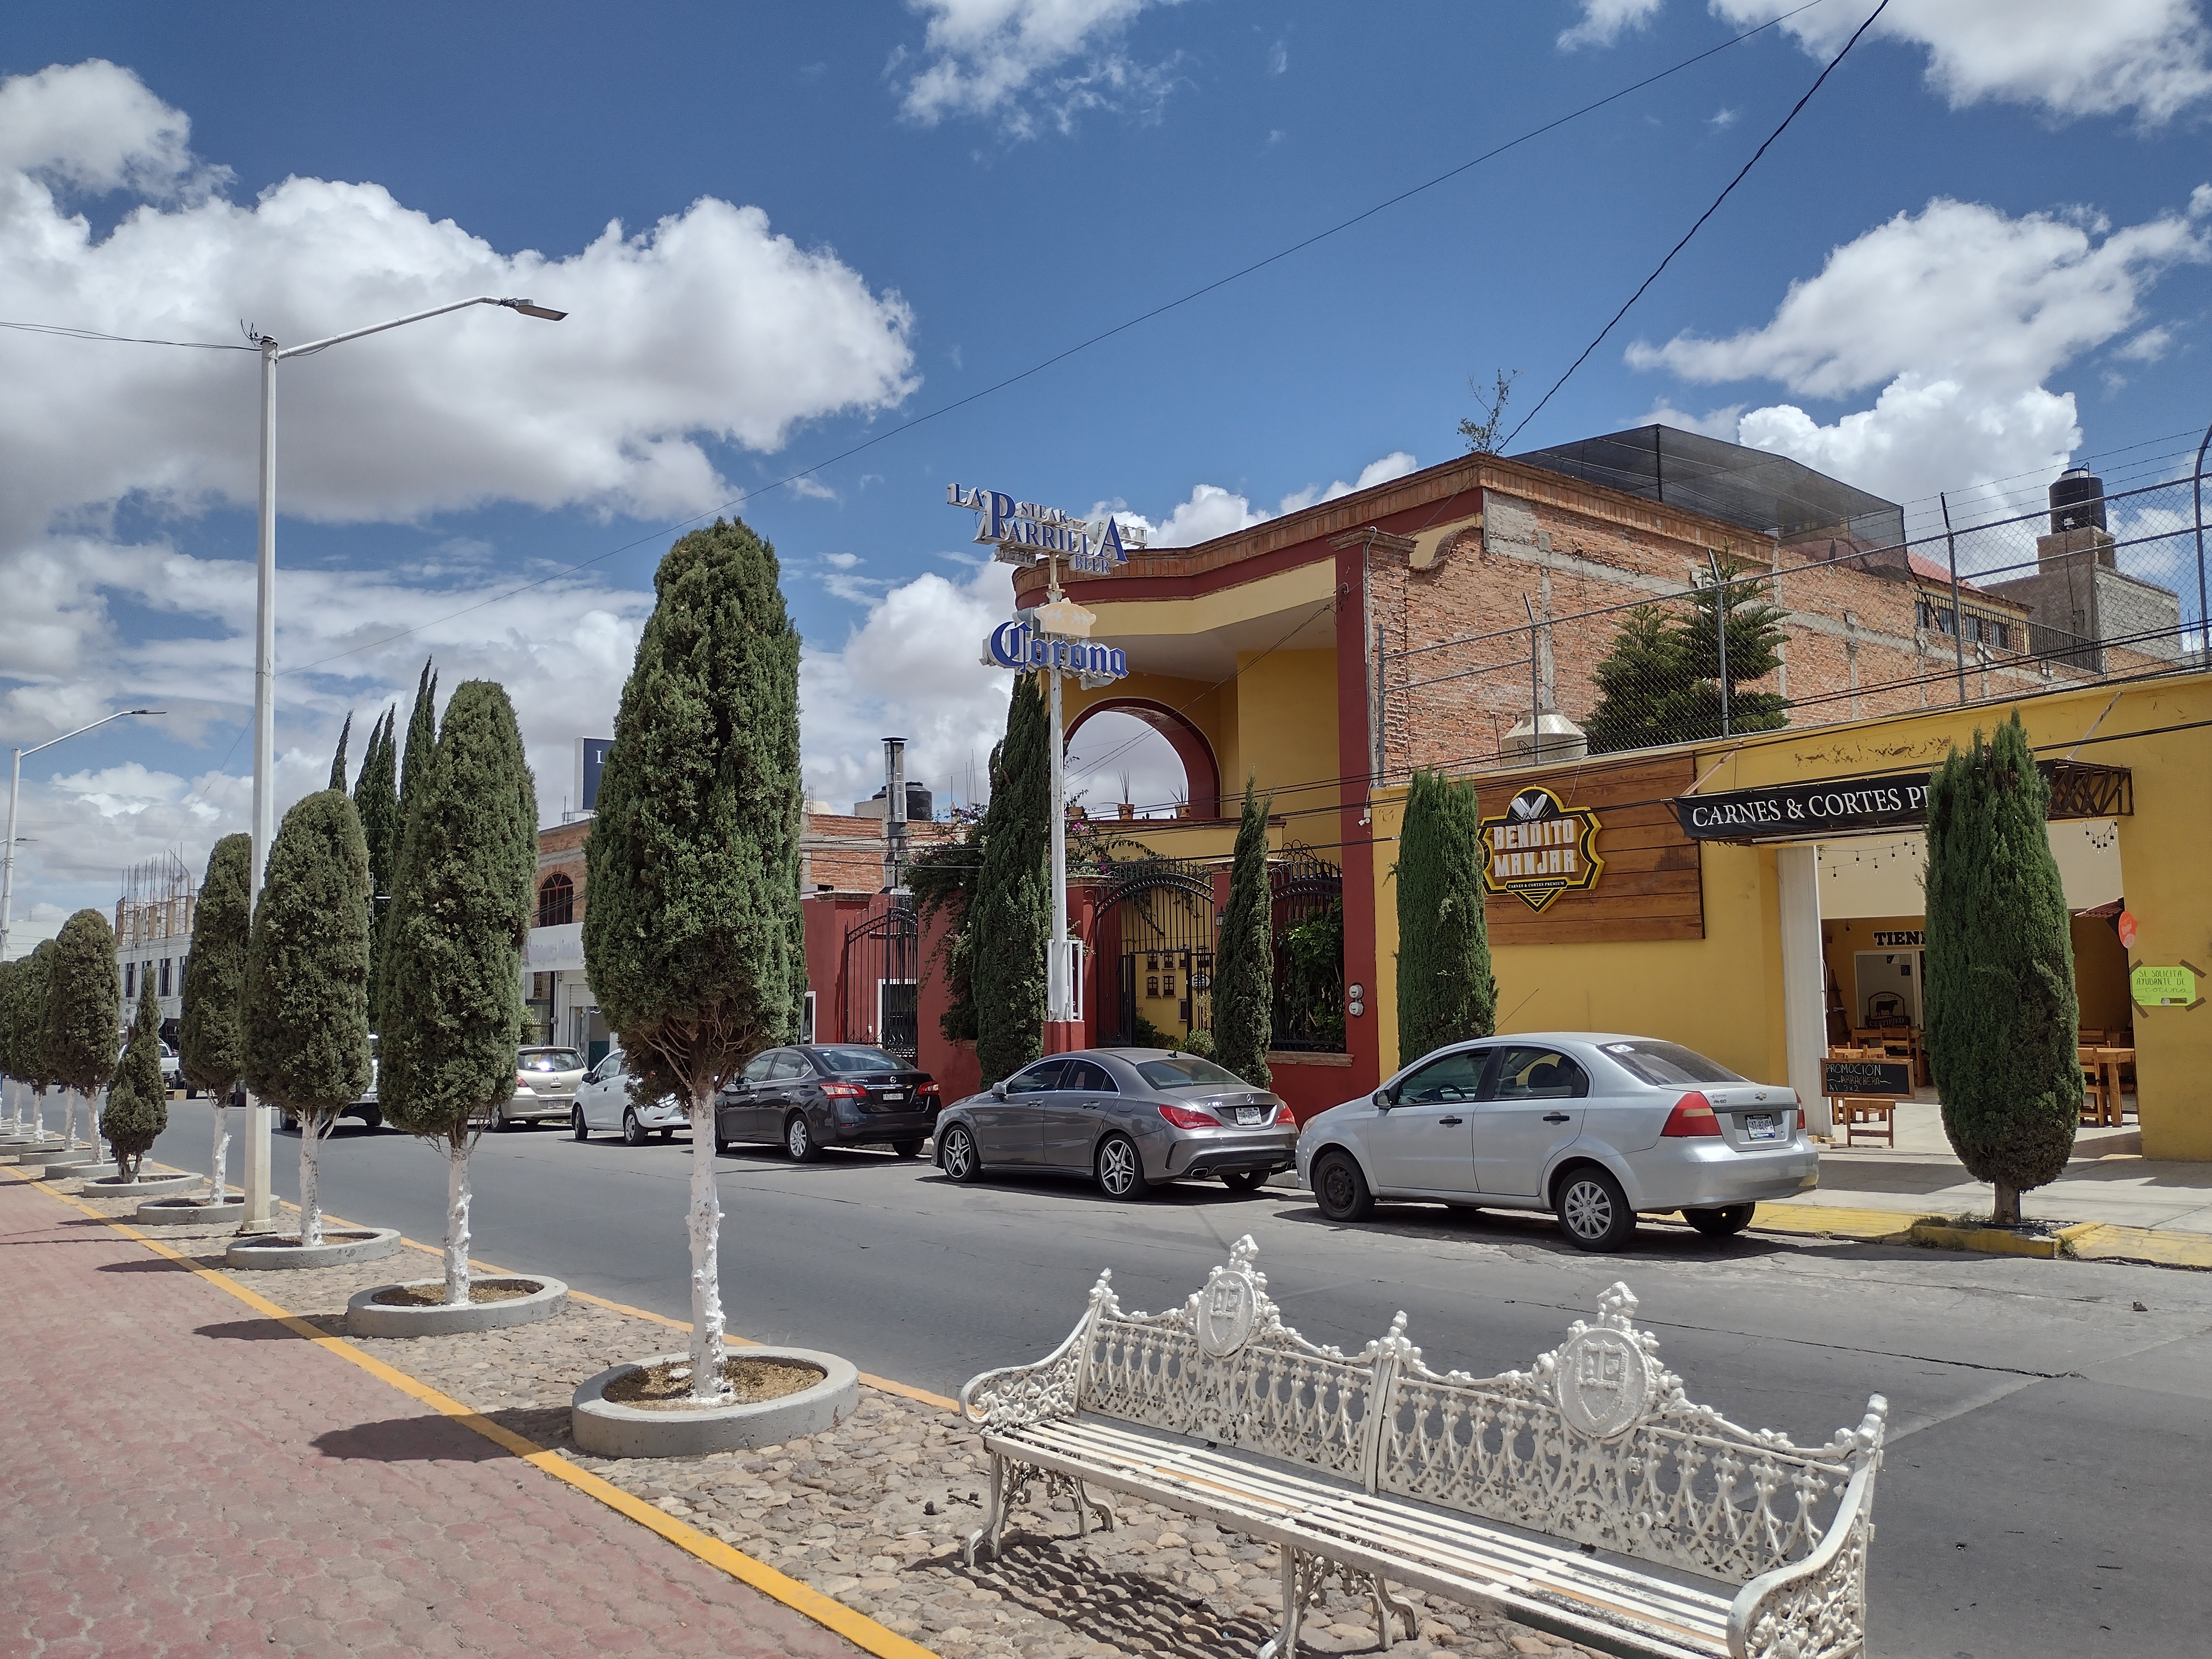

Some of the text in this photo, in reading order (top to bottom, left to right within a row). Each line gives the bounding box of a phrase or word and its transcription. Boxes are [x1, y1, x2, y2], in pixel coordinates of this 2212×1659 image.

[949, 483, 984, 508] LA
[1021, 501, 1068, 524] STEAK
[982, 489, 1129, 563] PARRILLA
[1075, 555, 1110, 574] BEER
[990, 620, 1129, 680] Corona
[1692, 800, 1781, 827] CARNES
[1786, 798, 1806, 819] &
[1808, 787, 1902, 817] CORTES
[1493, 818, 1576, 850] BENDITO
[1493, 849, 1577, 877] MANJAR
[2136, 978, 2171, 986] AYUDANTE
[1840, 1075, 1880, 1086] ARRACHERA
